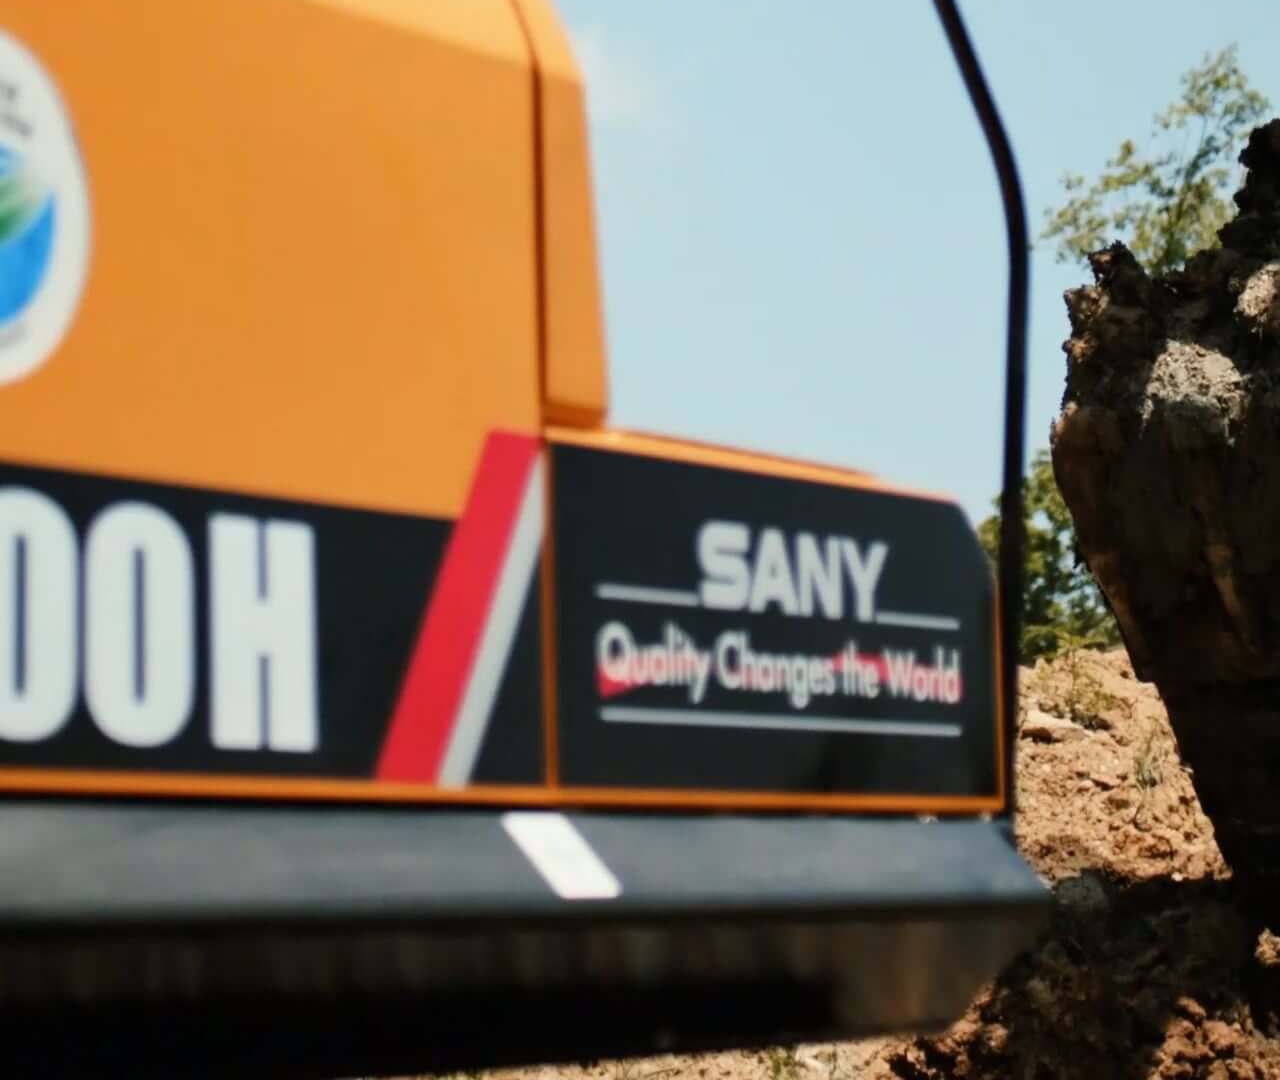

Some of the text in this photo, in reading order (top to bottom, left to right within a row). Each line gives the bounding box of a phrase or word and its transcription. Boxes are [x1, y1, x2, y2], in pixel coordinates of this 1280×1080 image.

[697, 520, 888, 621] SANY
[596, 621, 962, 708] Quality Changes the World
